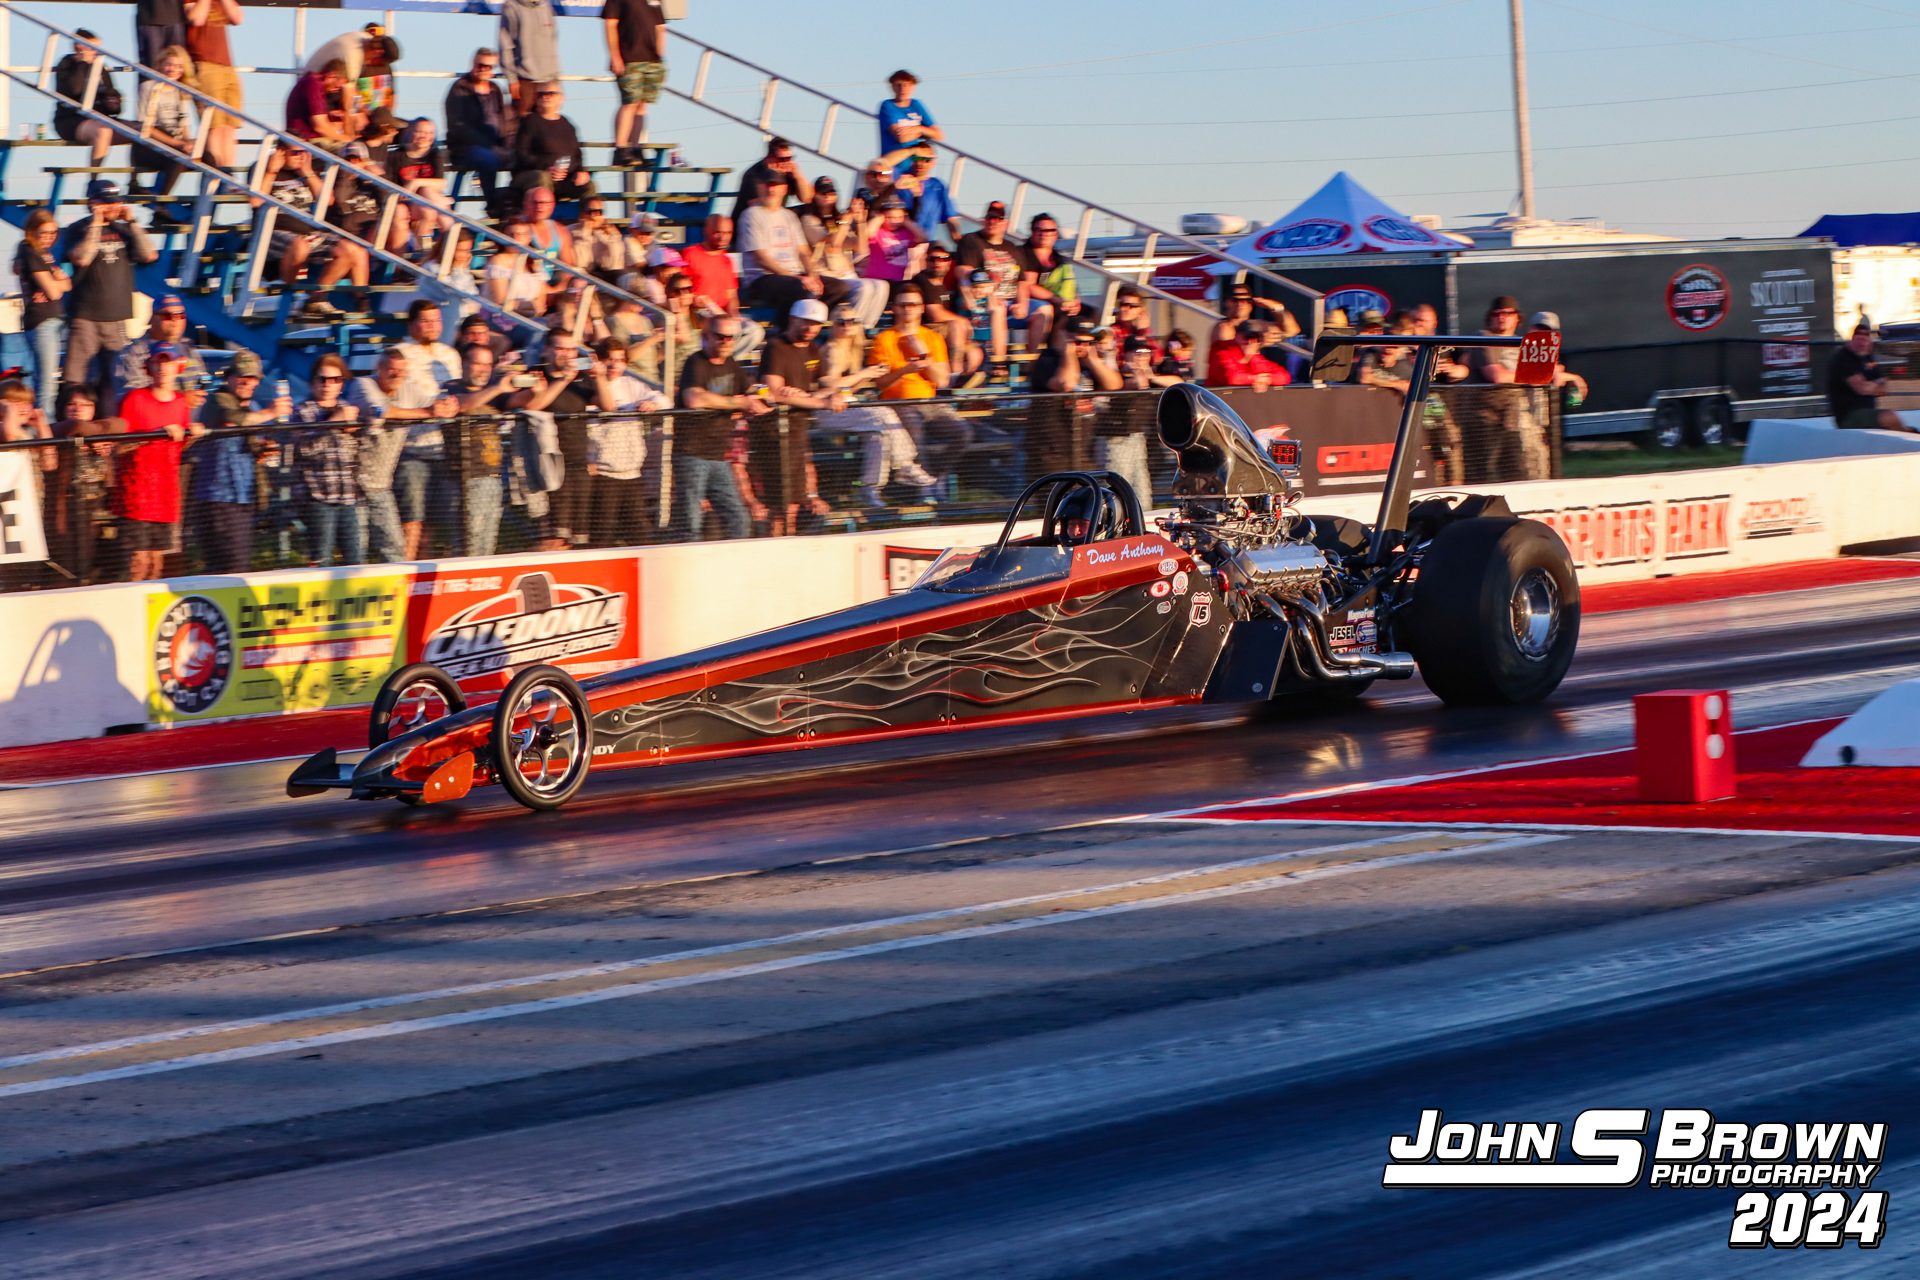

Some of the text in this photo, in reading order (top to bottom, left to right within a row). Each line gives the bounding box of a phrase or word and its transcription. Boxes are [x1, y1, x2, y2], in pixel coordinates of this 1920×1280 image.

[1521, 345, 1558, 363] 1257
[1543, 498, 1732, 564] SPORTS PARK
[1086, 542, 1164, 565] Dave Anthony
[427, 598, 624, 661] CALEDONIA
[1330, 626, 1356, 641] JESEL
